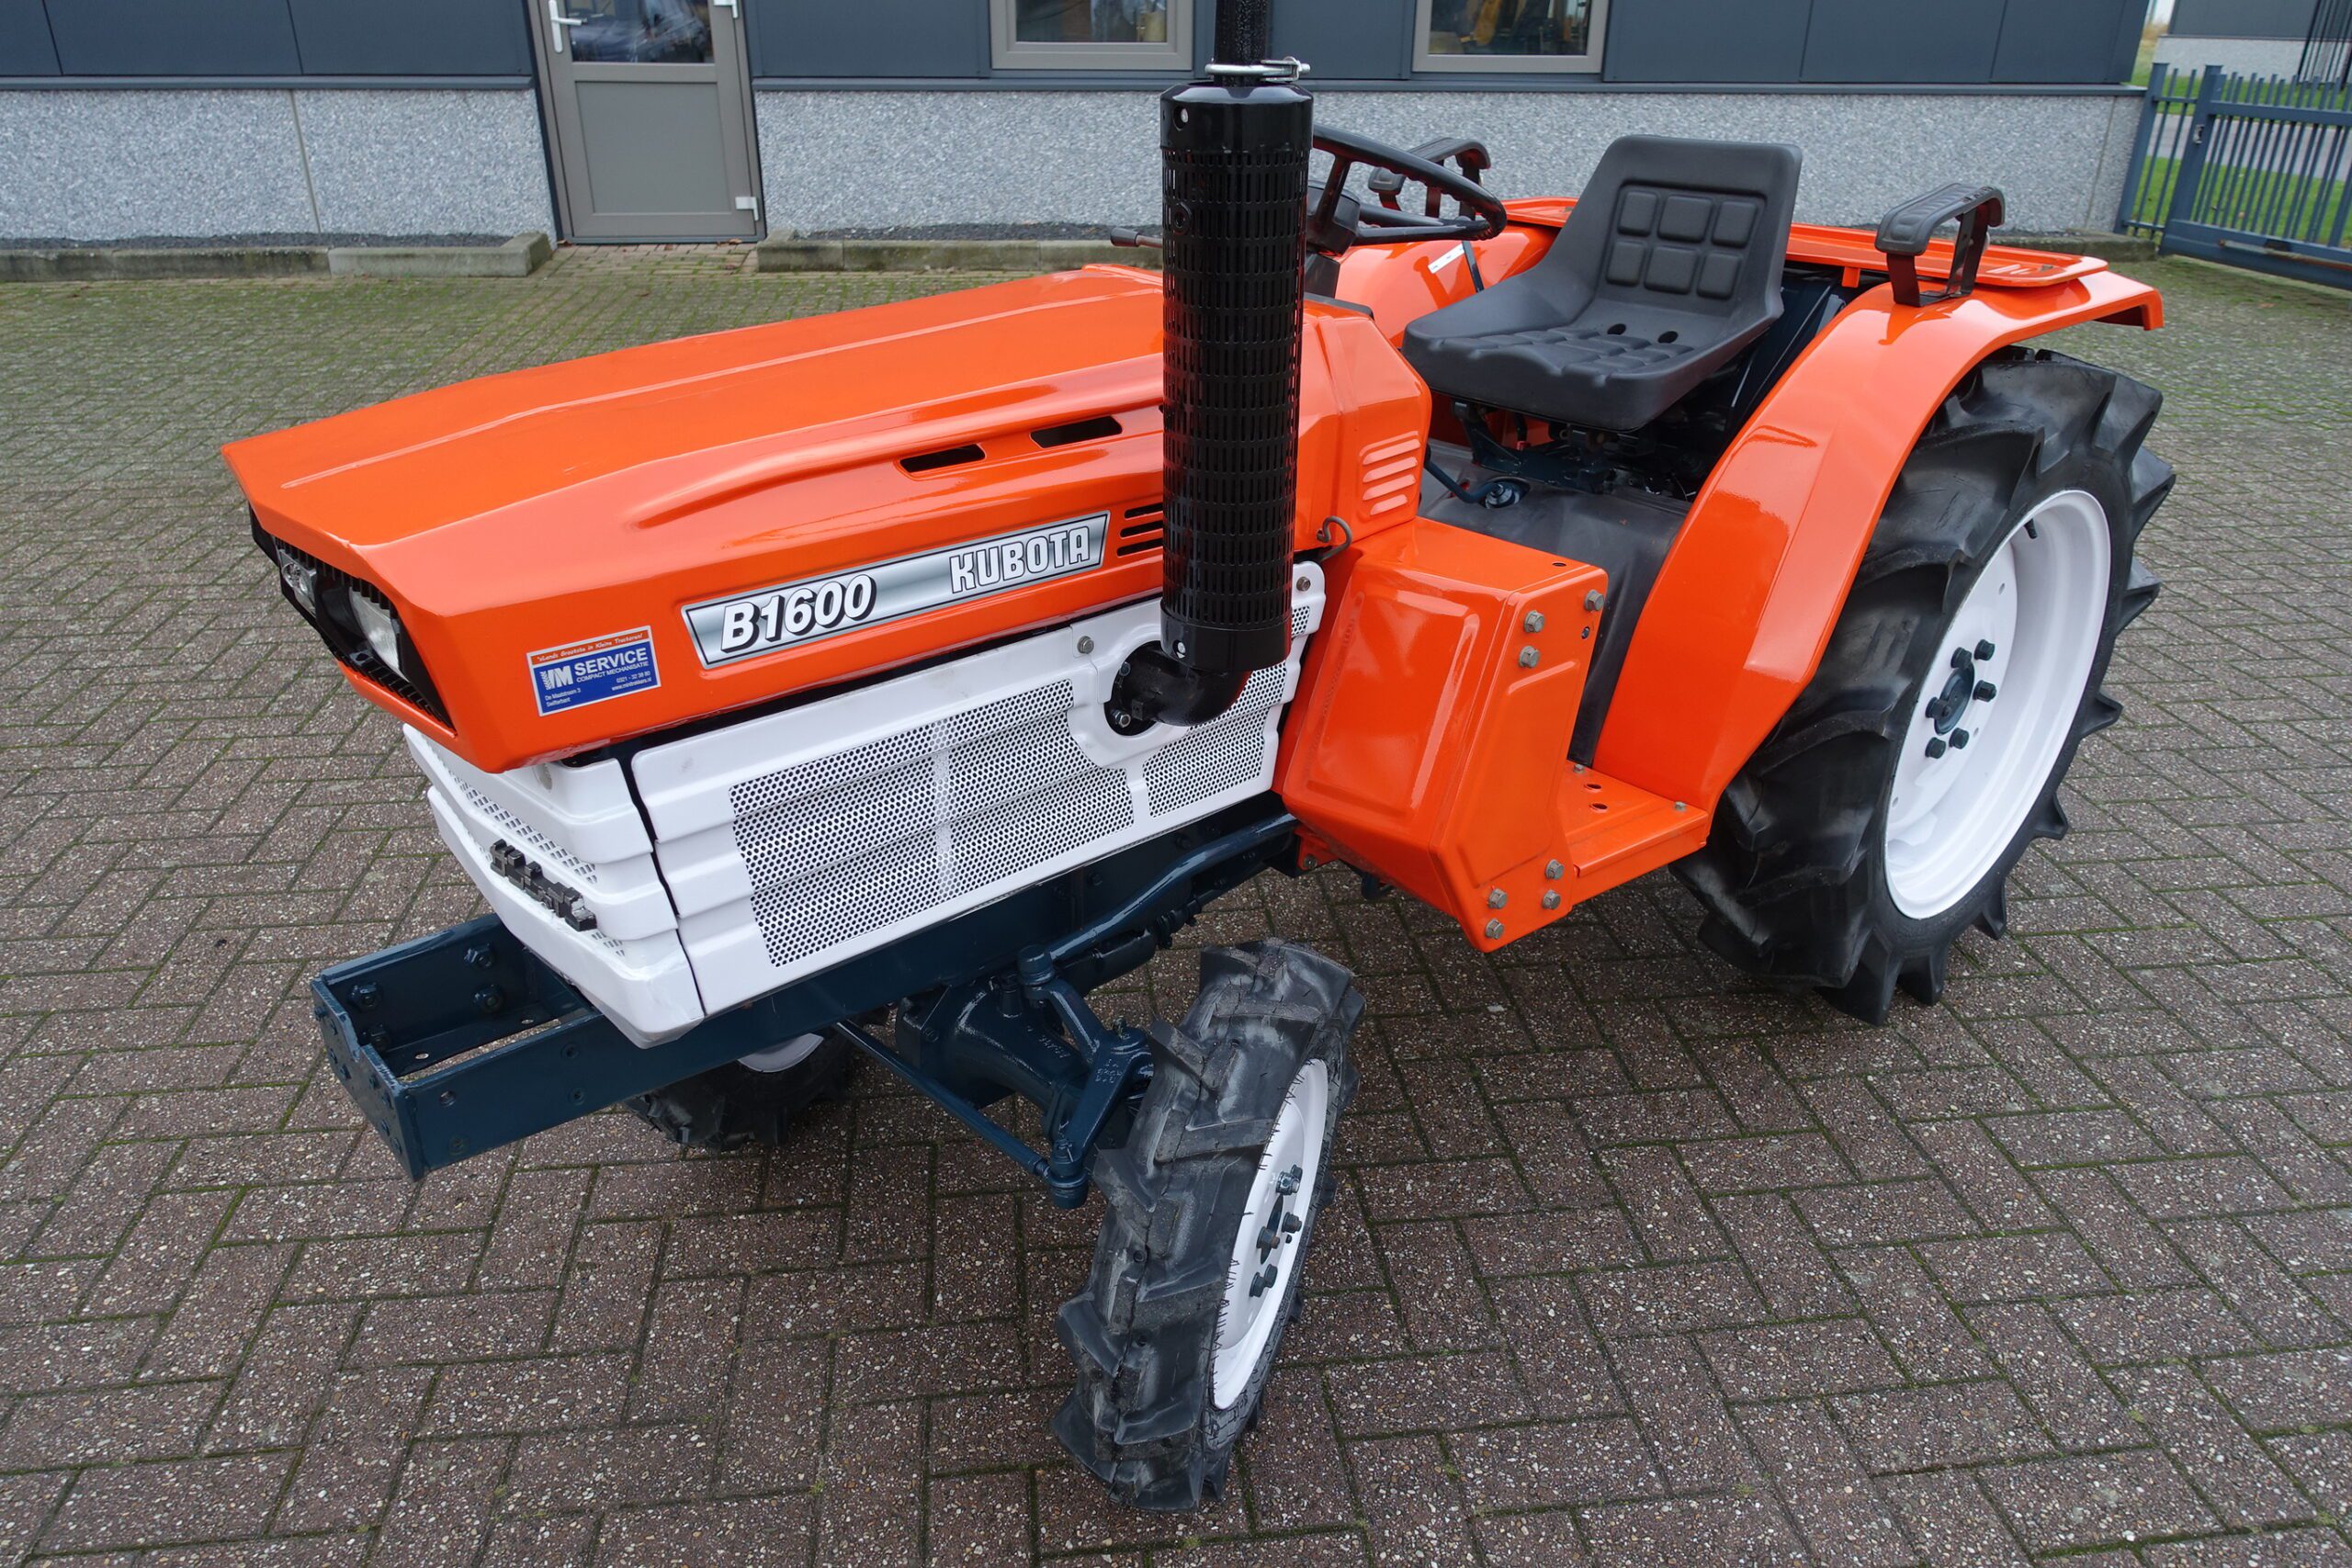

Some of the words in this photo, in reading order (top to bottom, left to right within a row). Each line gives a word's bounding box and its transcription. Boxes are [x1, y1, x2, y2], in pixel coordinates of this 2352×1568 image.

[949, 526, 1091, 594] KUBOTA
[721, 574, 876, 653] B1600
[574, 648, 649, 676] SERVICE
[576, 672, 605, 683] COMPACT
[606, 661, 650, 677] MECHANISATIE
